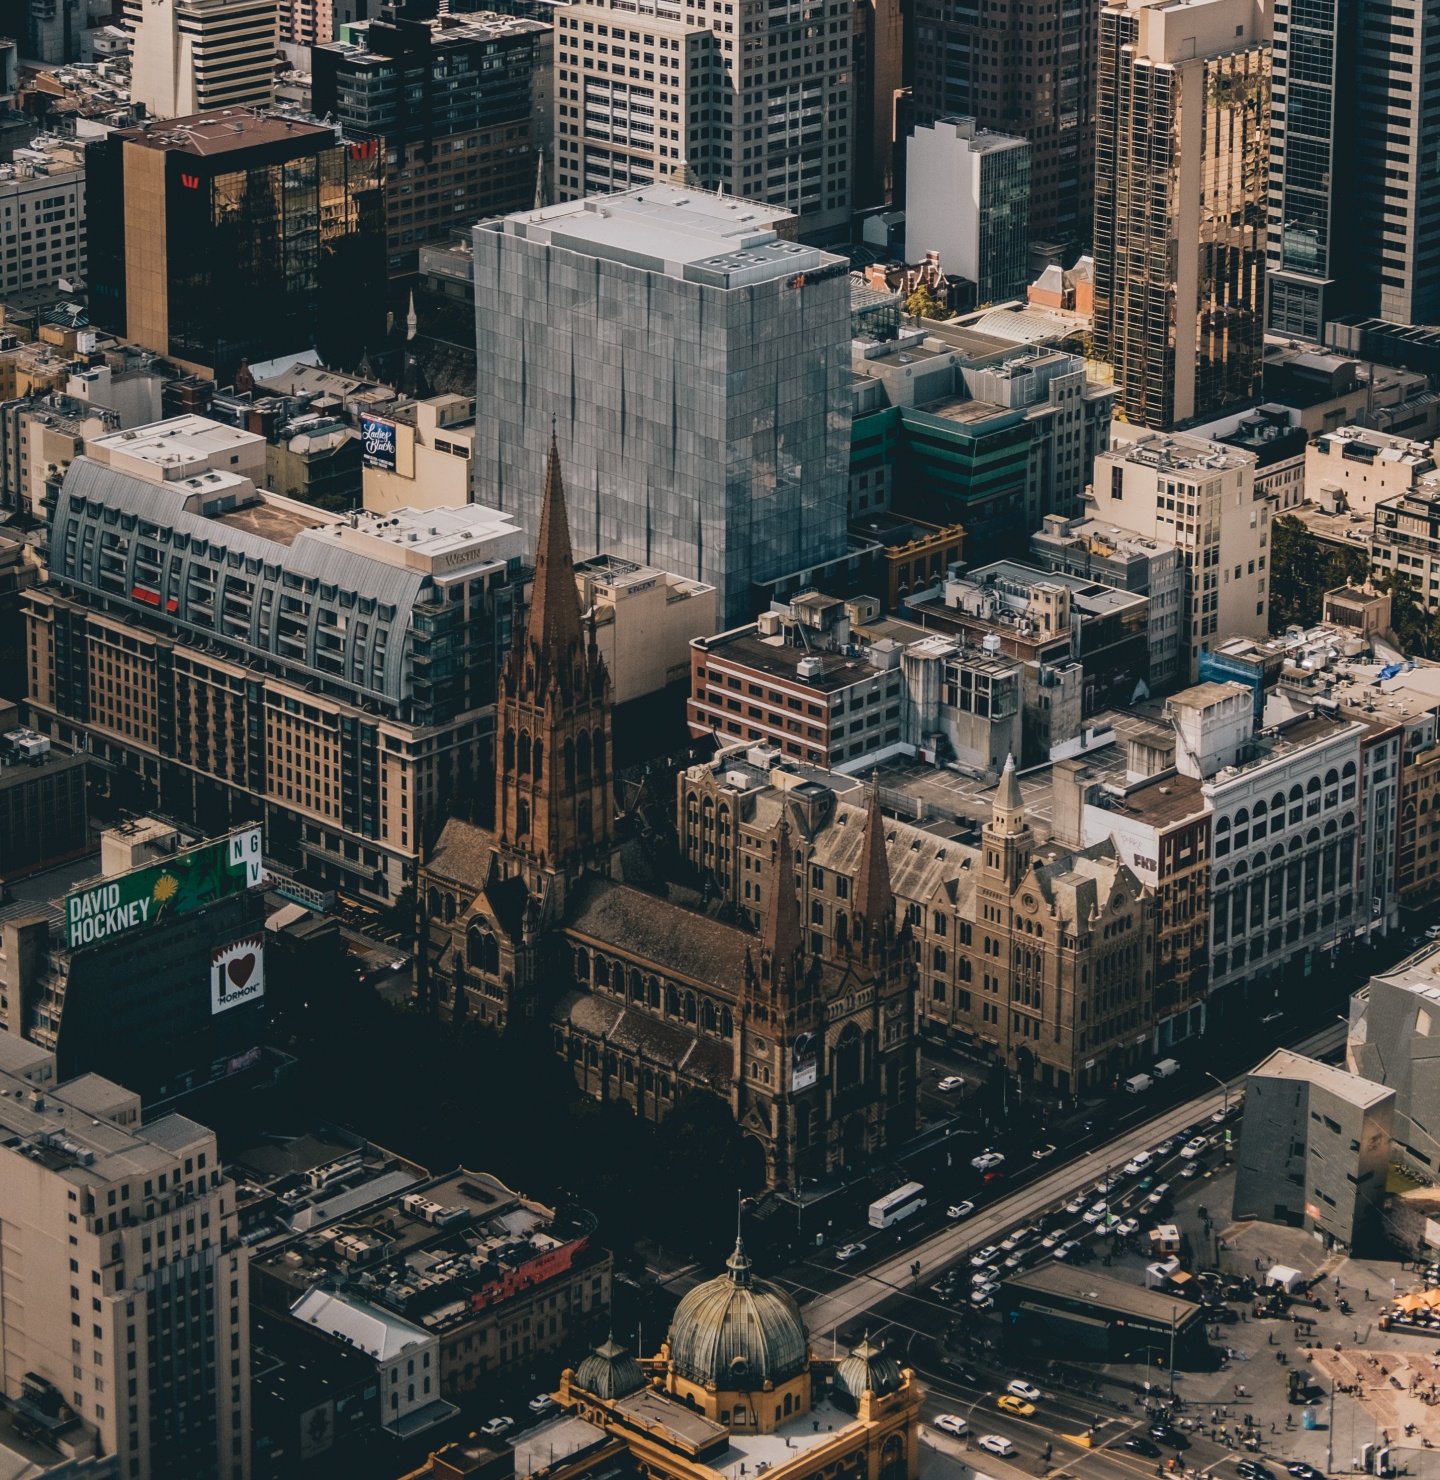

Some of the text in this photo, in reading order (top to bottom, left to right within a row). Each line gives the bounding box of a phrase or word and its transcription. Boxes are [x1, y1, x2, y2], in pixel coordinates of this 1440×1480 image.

[362, 423, 392, 442] Ladies
[365, 439, 396, 454] Black
[446, 548, 481, 567] WESTIN
[70, 883, 120, 923] DAVID
[71, 896, 150, 948] HOCKNEY
